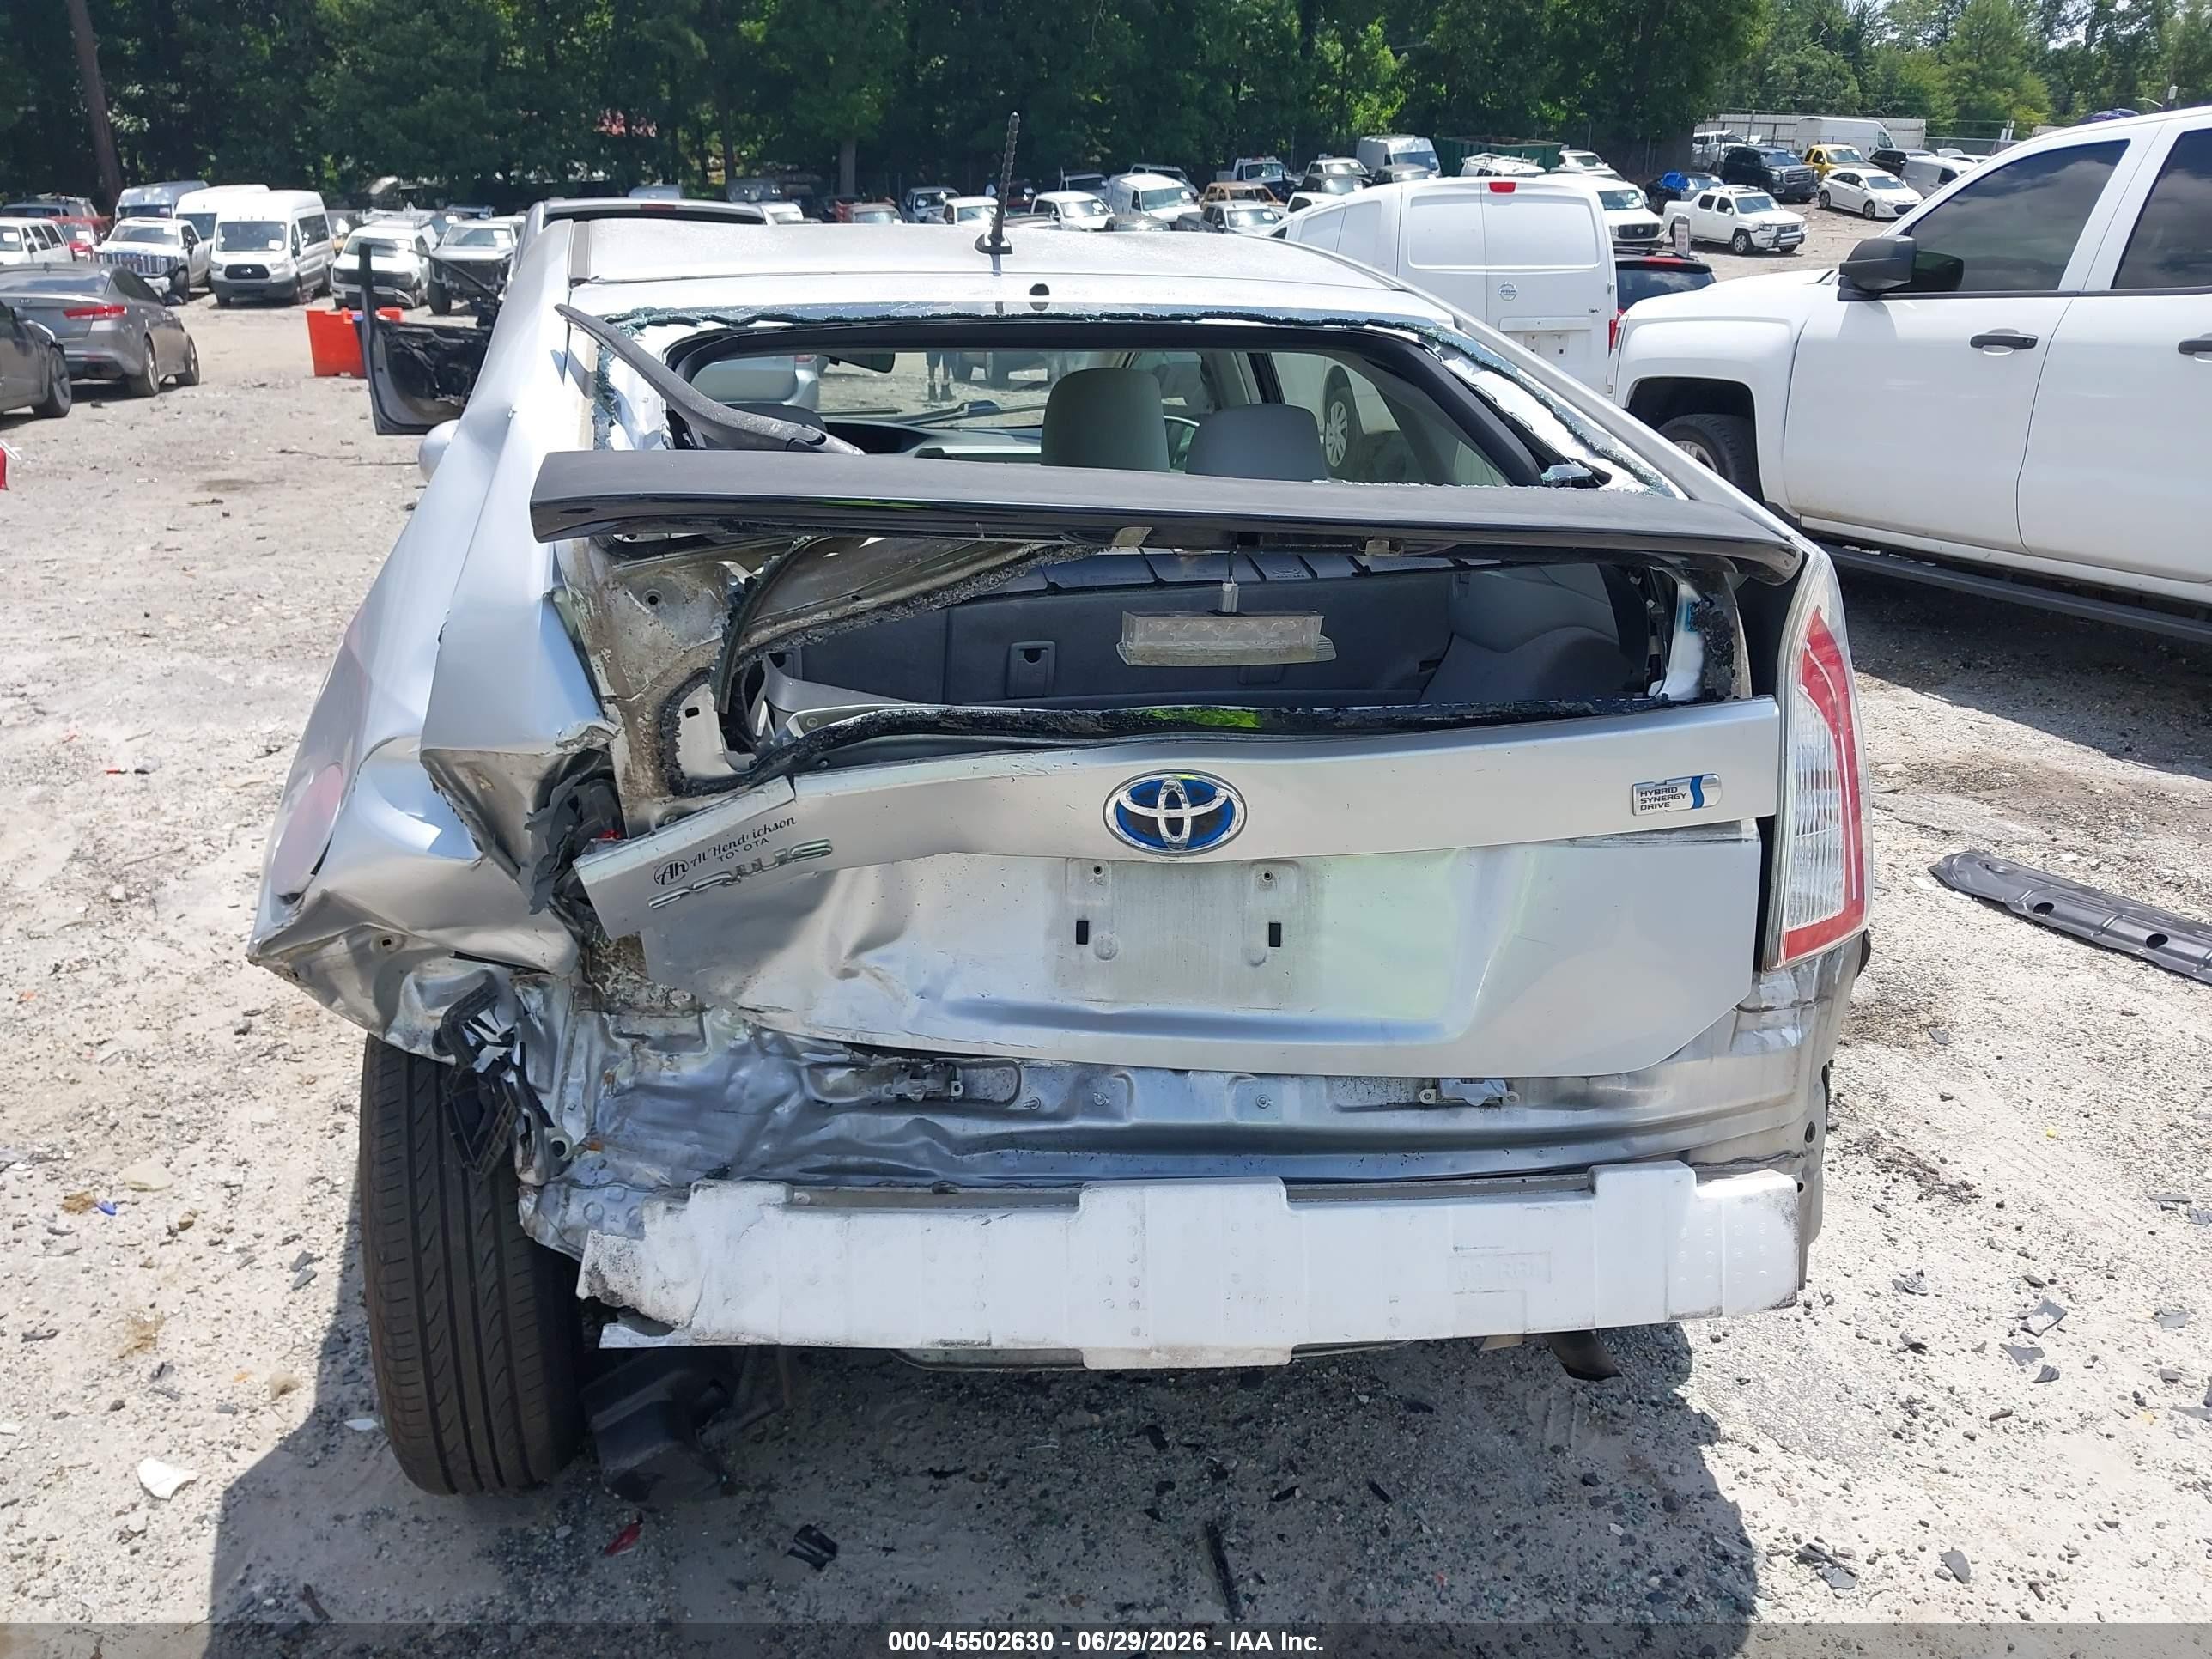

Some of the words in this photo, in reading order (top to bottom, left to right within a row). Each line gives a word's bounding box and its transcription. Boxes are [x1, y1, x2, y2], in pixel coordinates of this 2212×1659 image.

[1640, 787, 1678, 797] HYBRID
[1640, 793, 1687, 804] SYNERGY
[1640, 802, 1670, 811] DRIVE
